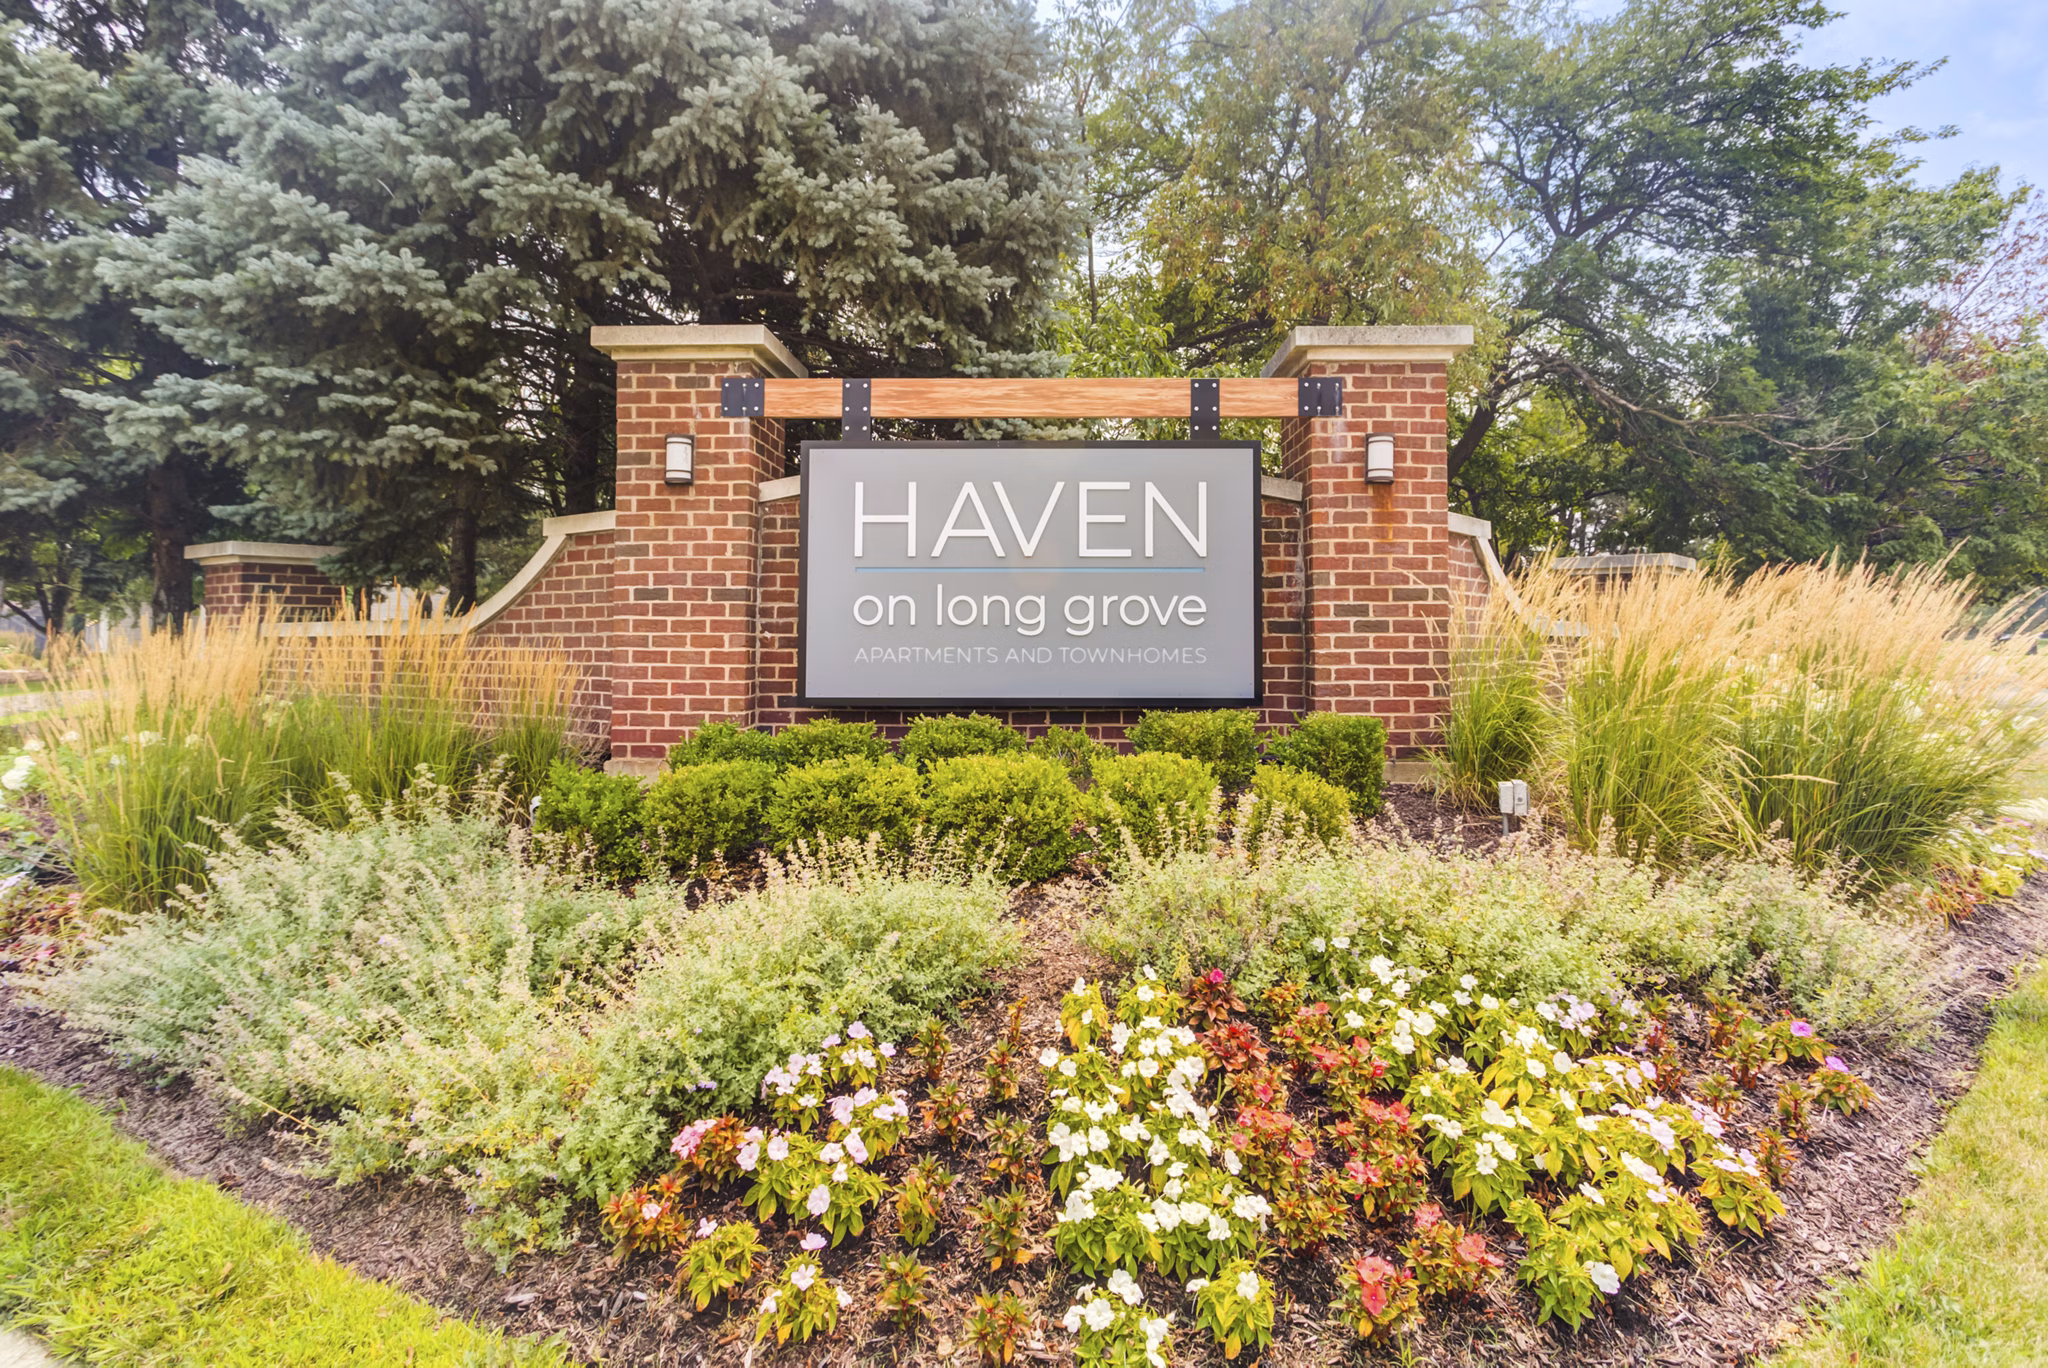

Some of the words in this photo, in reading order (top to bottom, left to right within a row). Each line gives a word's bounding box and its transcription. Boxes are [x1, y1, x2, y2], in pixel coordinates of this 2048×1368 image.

[854, 481, 1208, 557] HAVEN
[853, 594, 916, 626] on
[936, 583, 1046, 636] long
[1063, 594, 1207, 636] grove
[854, 646, 999, 664] APARTMENTS
[1004, 646, 1053, 664] AND
[1058, 646, 1207, 664] TOWNHOMES
